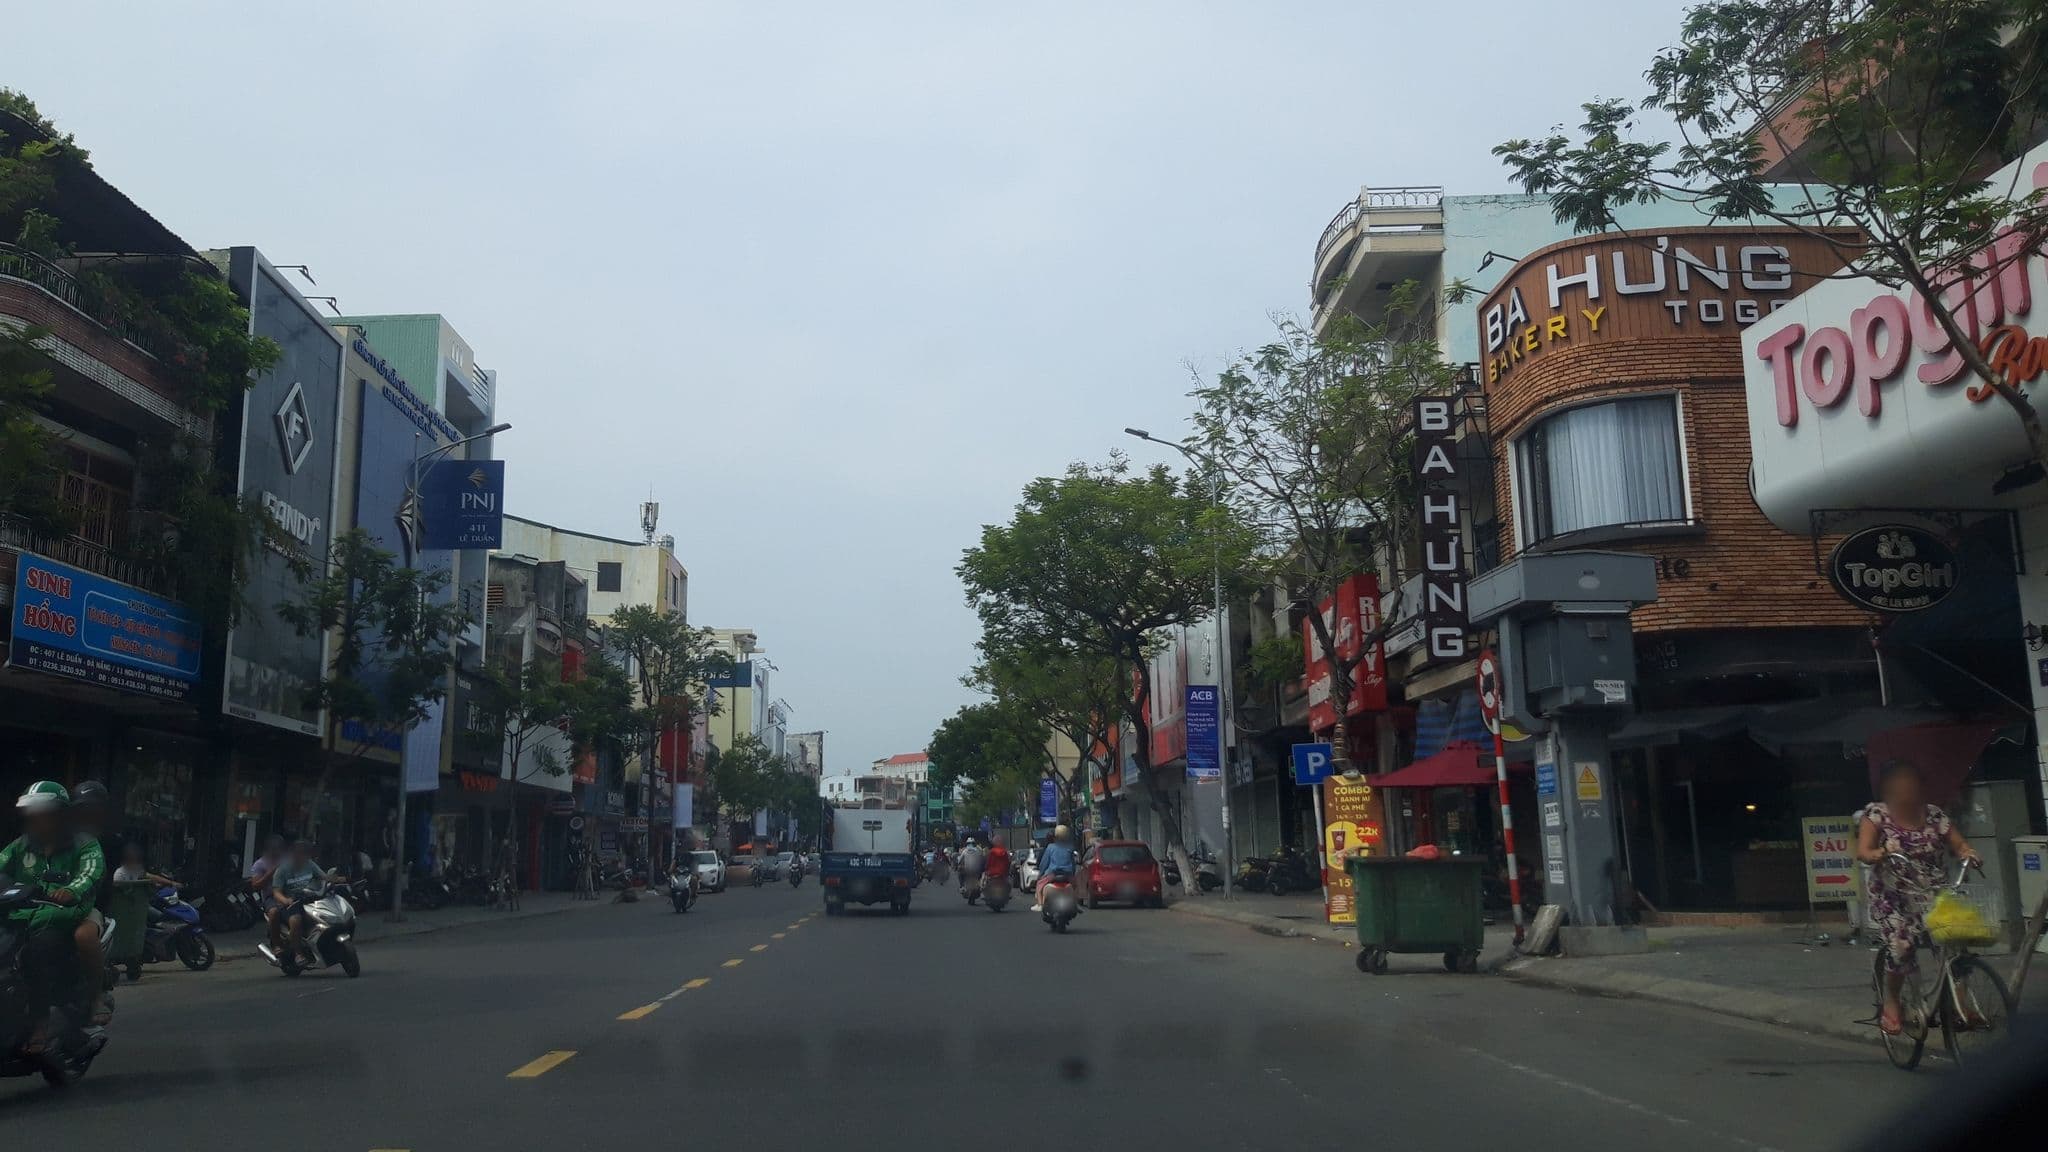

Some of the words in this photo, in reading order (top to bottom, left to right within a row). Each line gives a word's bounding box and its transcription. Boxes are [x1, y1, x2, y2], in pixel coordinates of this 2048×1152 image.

[1486, 287, 1529, 355] BA
[1547, 236, 1793, 309] HƯNG
[1489, 306, 1606, 384] BAKERY
[461, 492, 496, 513] PNJ
[26, 567, 73, 599] SINH
[1844, 562, 1953, 594] TopGirl
[23, 598, 77, 638] HỒNG
[1190, 690, 1213, 701] ACB
[1307, 752, 1326, 777] P
[1333, 785, 1371, 795] COMBO
[1814, 836, 1848, 852] SÁU
